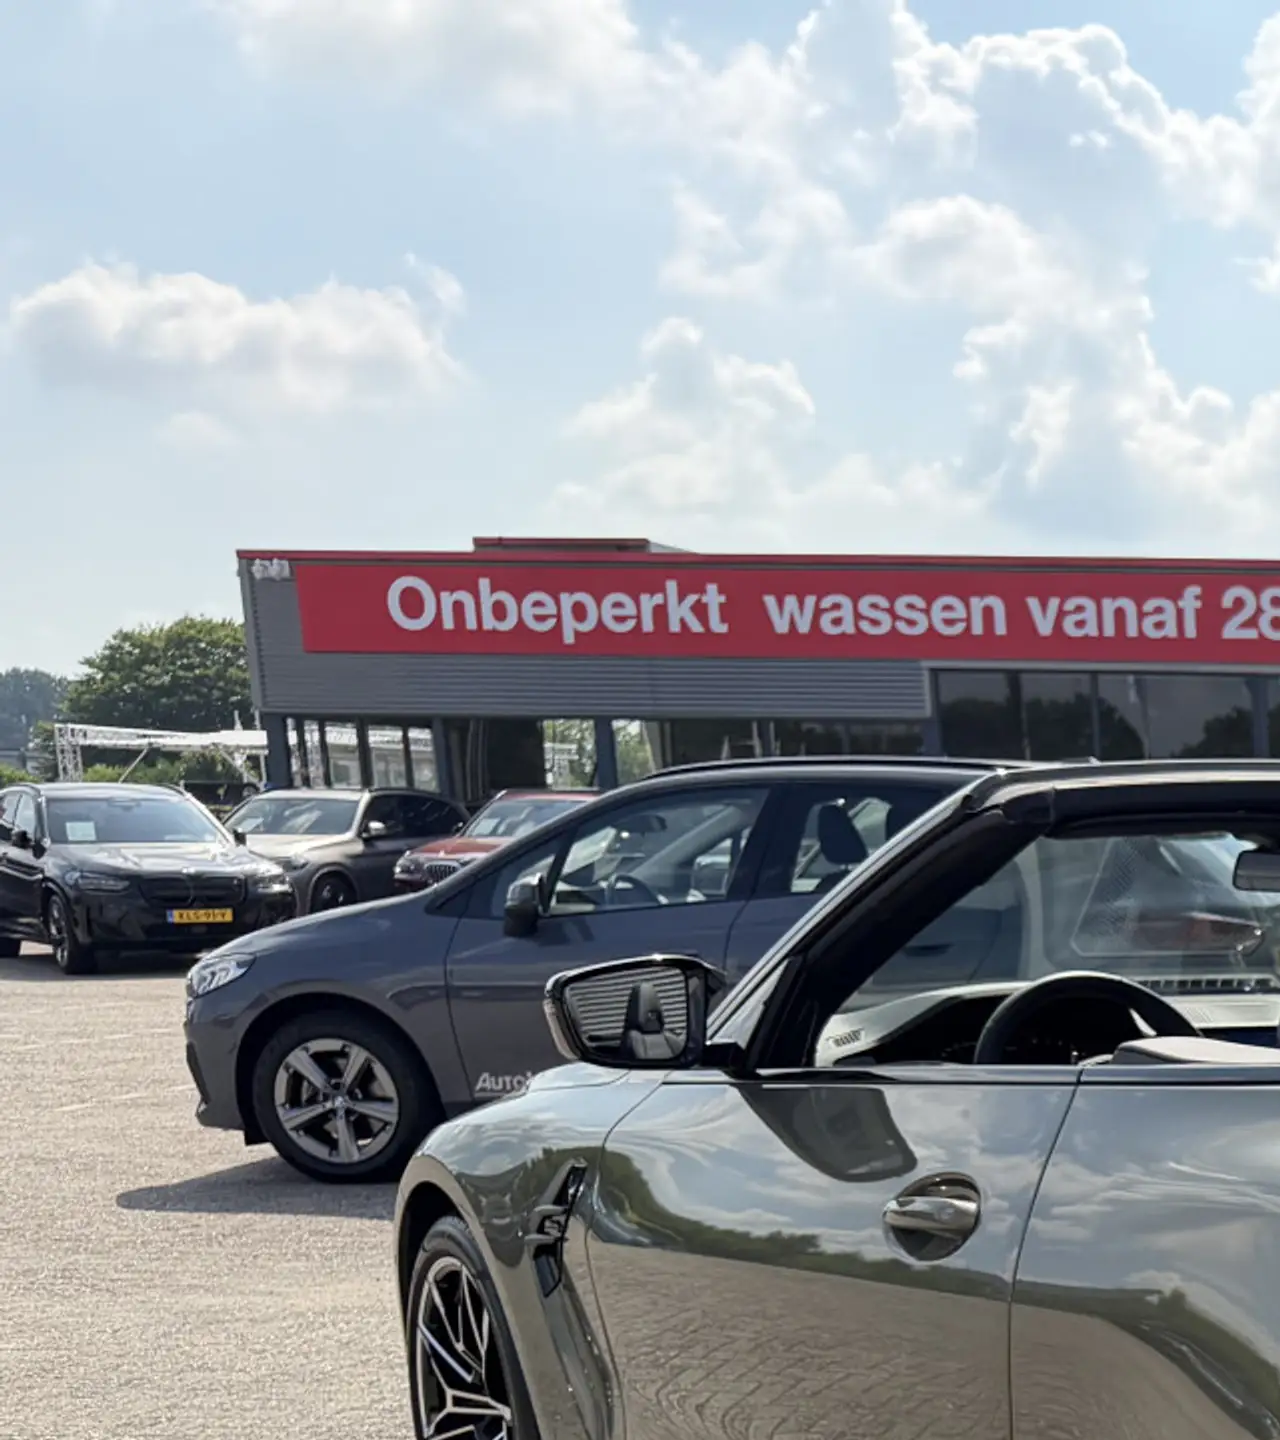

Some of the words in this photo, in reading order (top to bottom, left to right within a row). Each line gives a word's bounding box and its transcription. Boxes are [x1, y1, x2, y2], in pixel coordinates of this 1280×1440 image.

[387, 575, 729, 645] Onbeperkt
[762, 592, 1008, 637] wassen
[1026, 584, 1203, 639] vanaf
